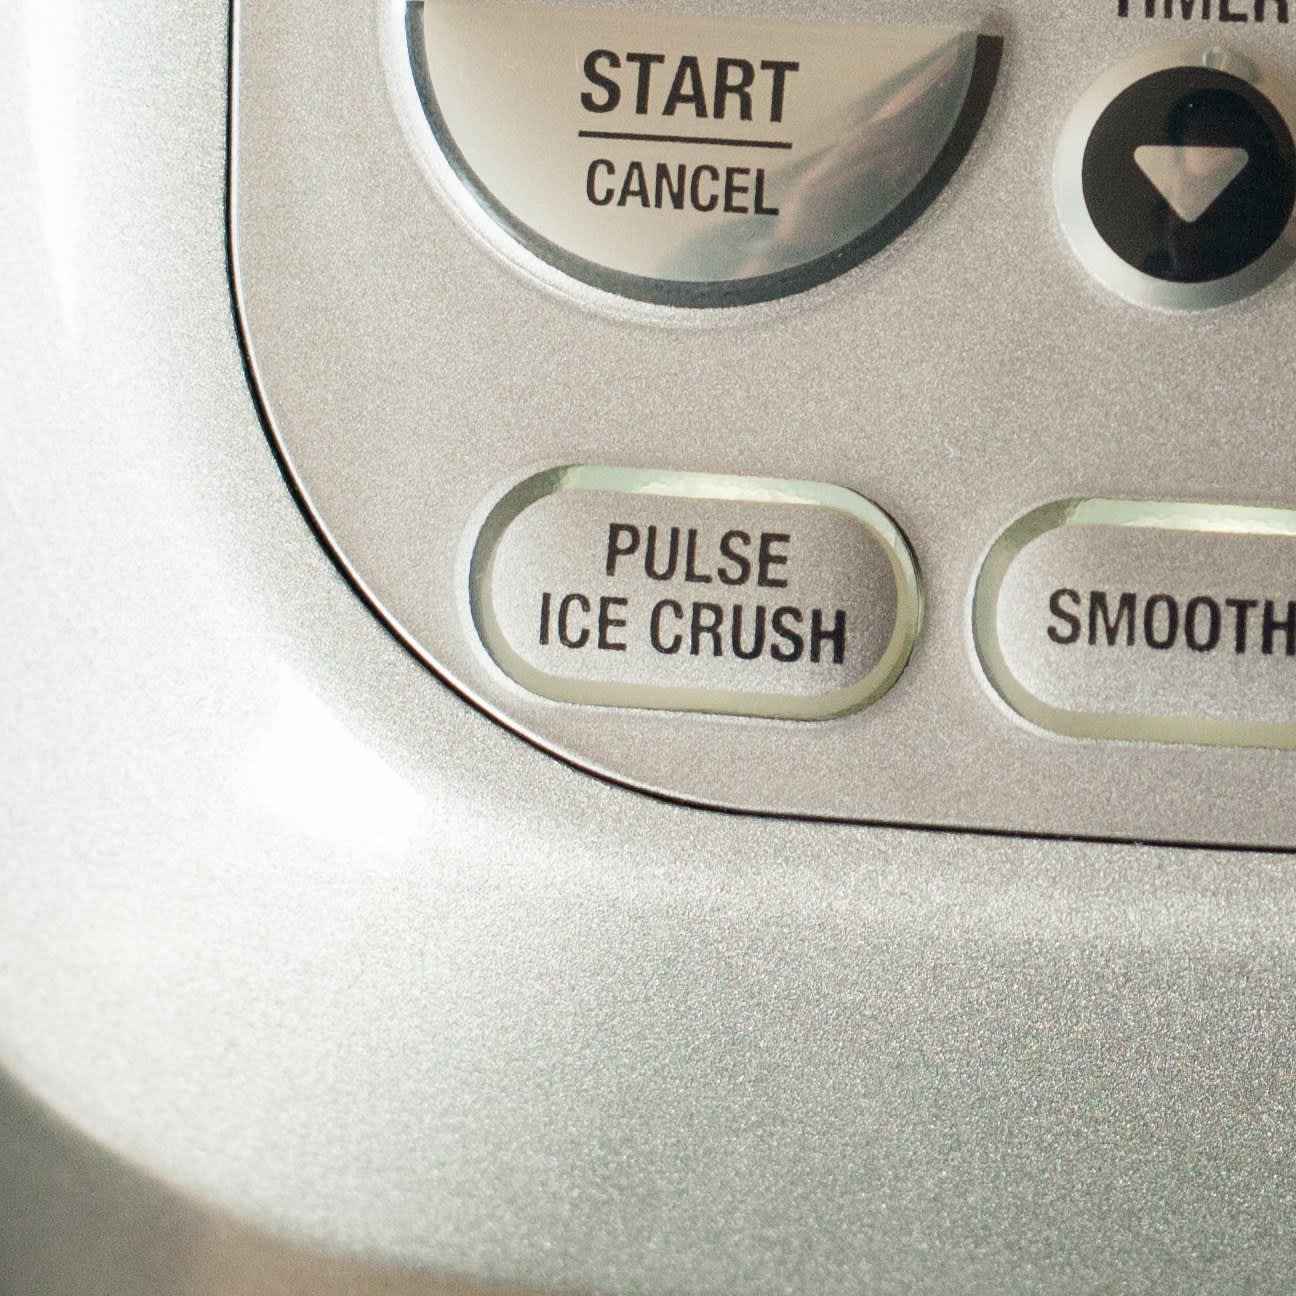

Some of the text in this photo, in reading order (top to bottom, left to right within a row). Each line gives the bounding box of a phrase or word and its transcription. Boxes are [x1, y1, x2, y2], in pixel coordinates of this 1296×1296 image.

[579, 48, 800, 124] START
[585, 157, 781, 217] CANCEL
[606, 522, 791, 590] PULSE
[539, 591, 847, 666] ICE CRUSH
